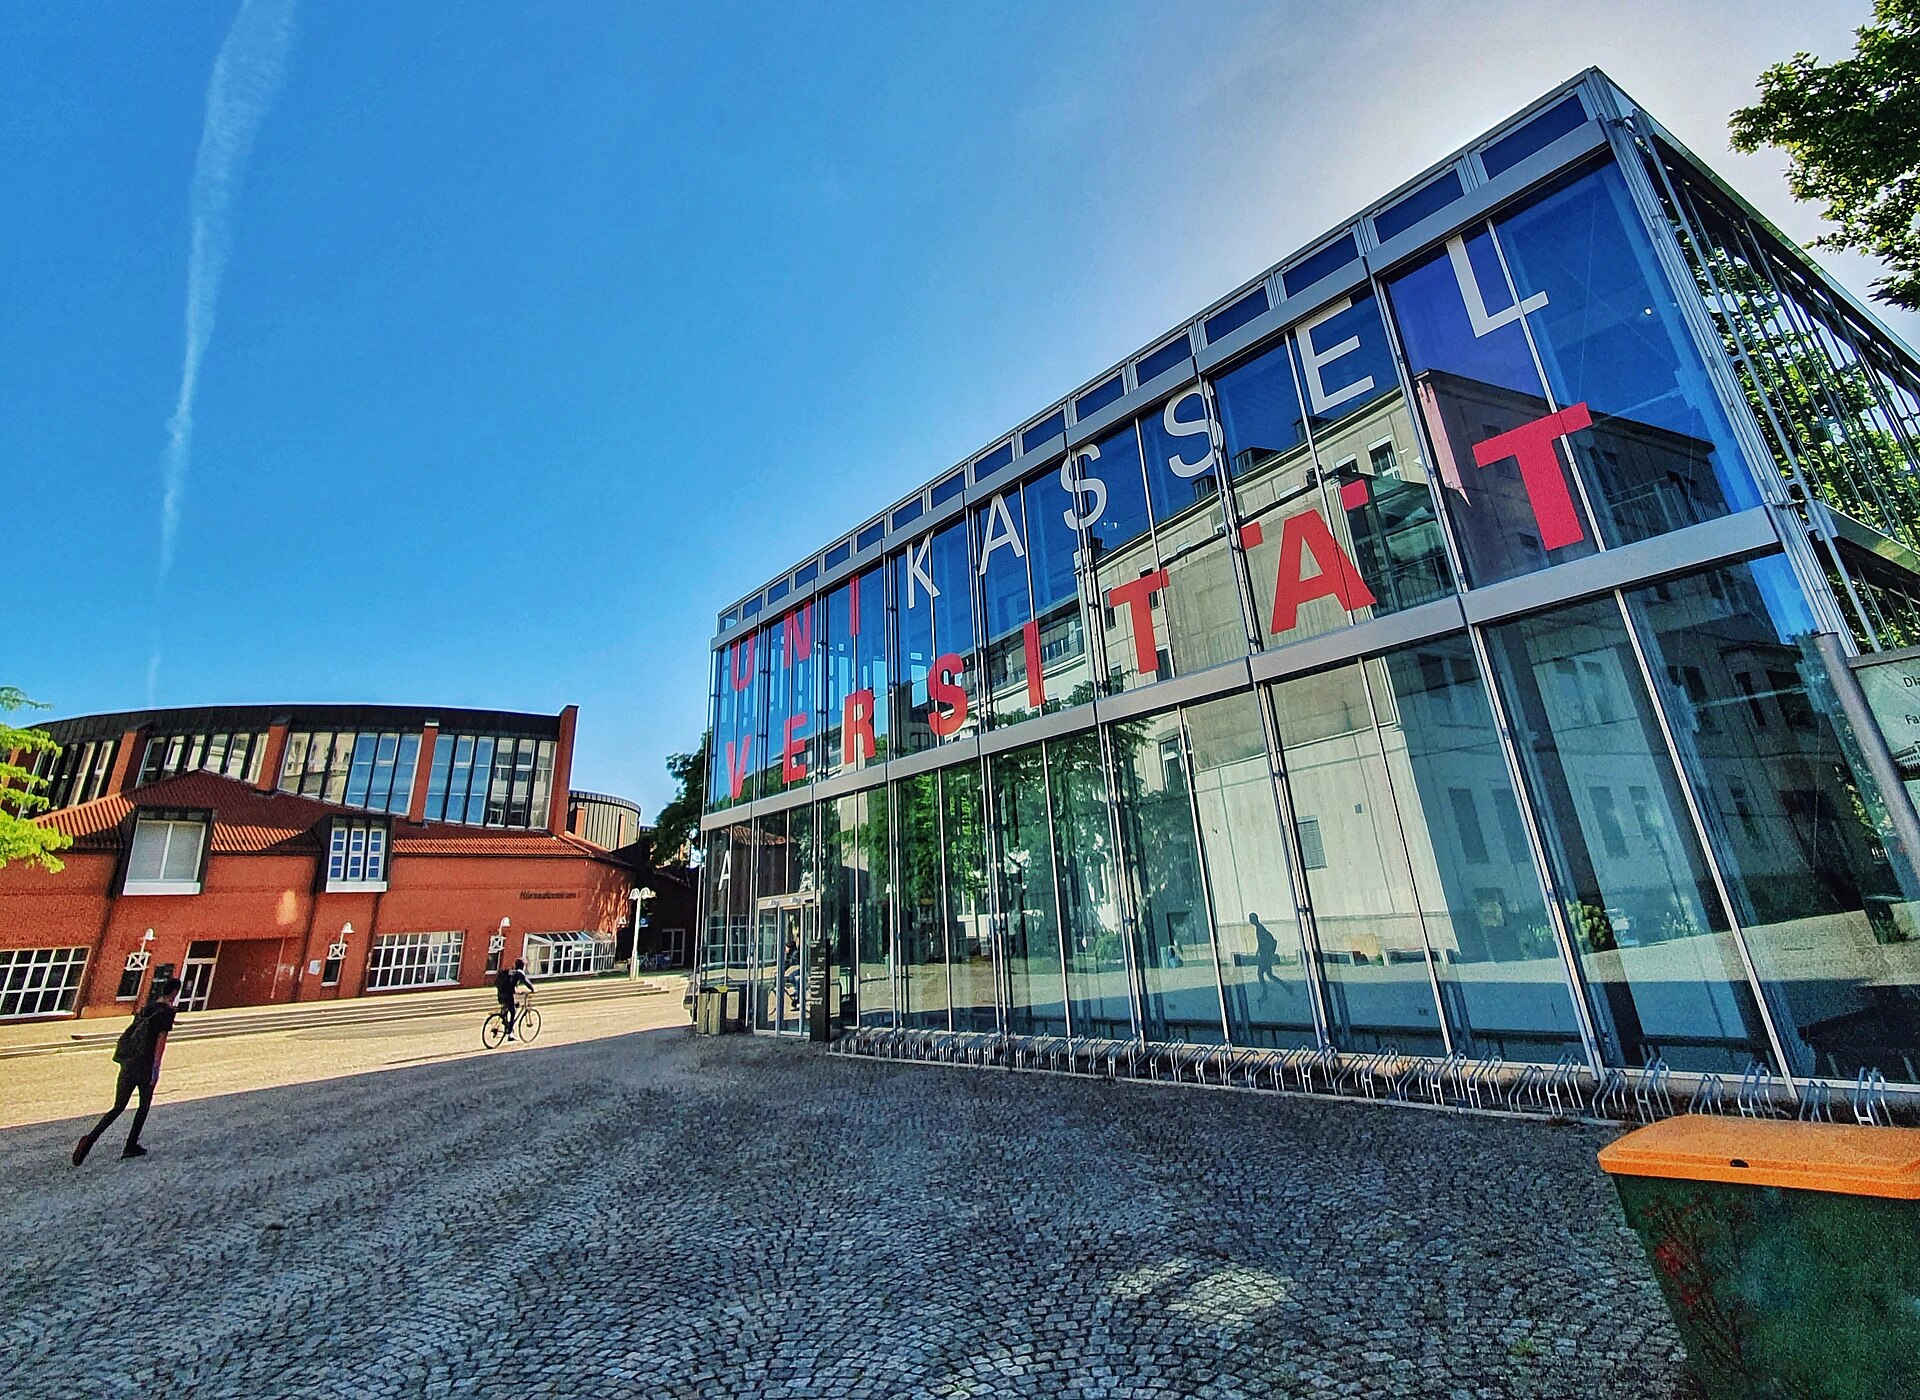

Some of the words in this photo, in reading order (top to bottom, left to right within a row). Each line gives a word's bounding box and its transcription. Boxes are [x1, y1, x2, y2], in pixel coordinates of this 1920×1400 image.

[725, 401, 1593, 799] VERSITÄT
[730, 574, 861, 692] UNI
[906, 235, 1549, 609] KASSEL
